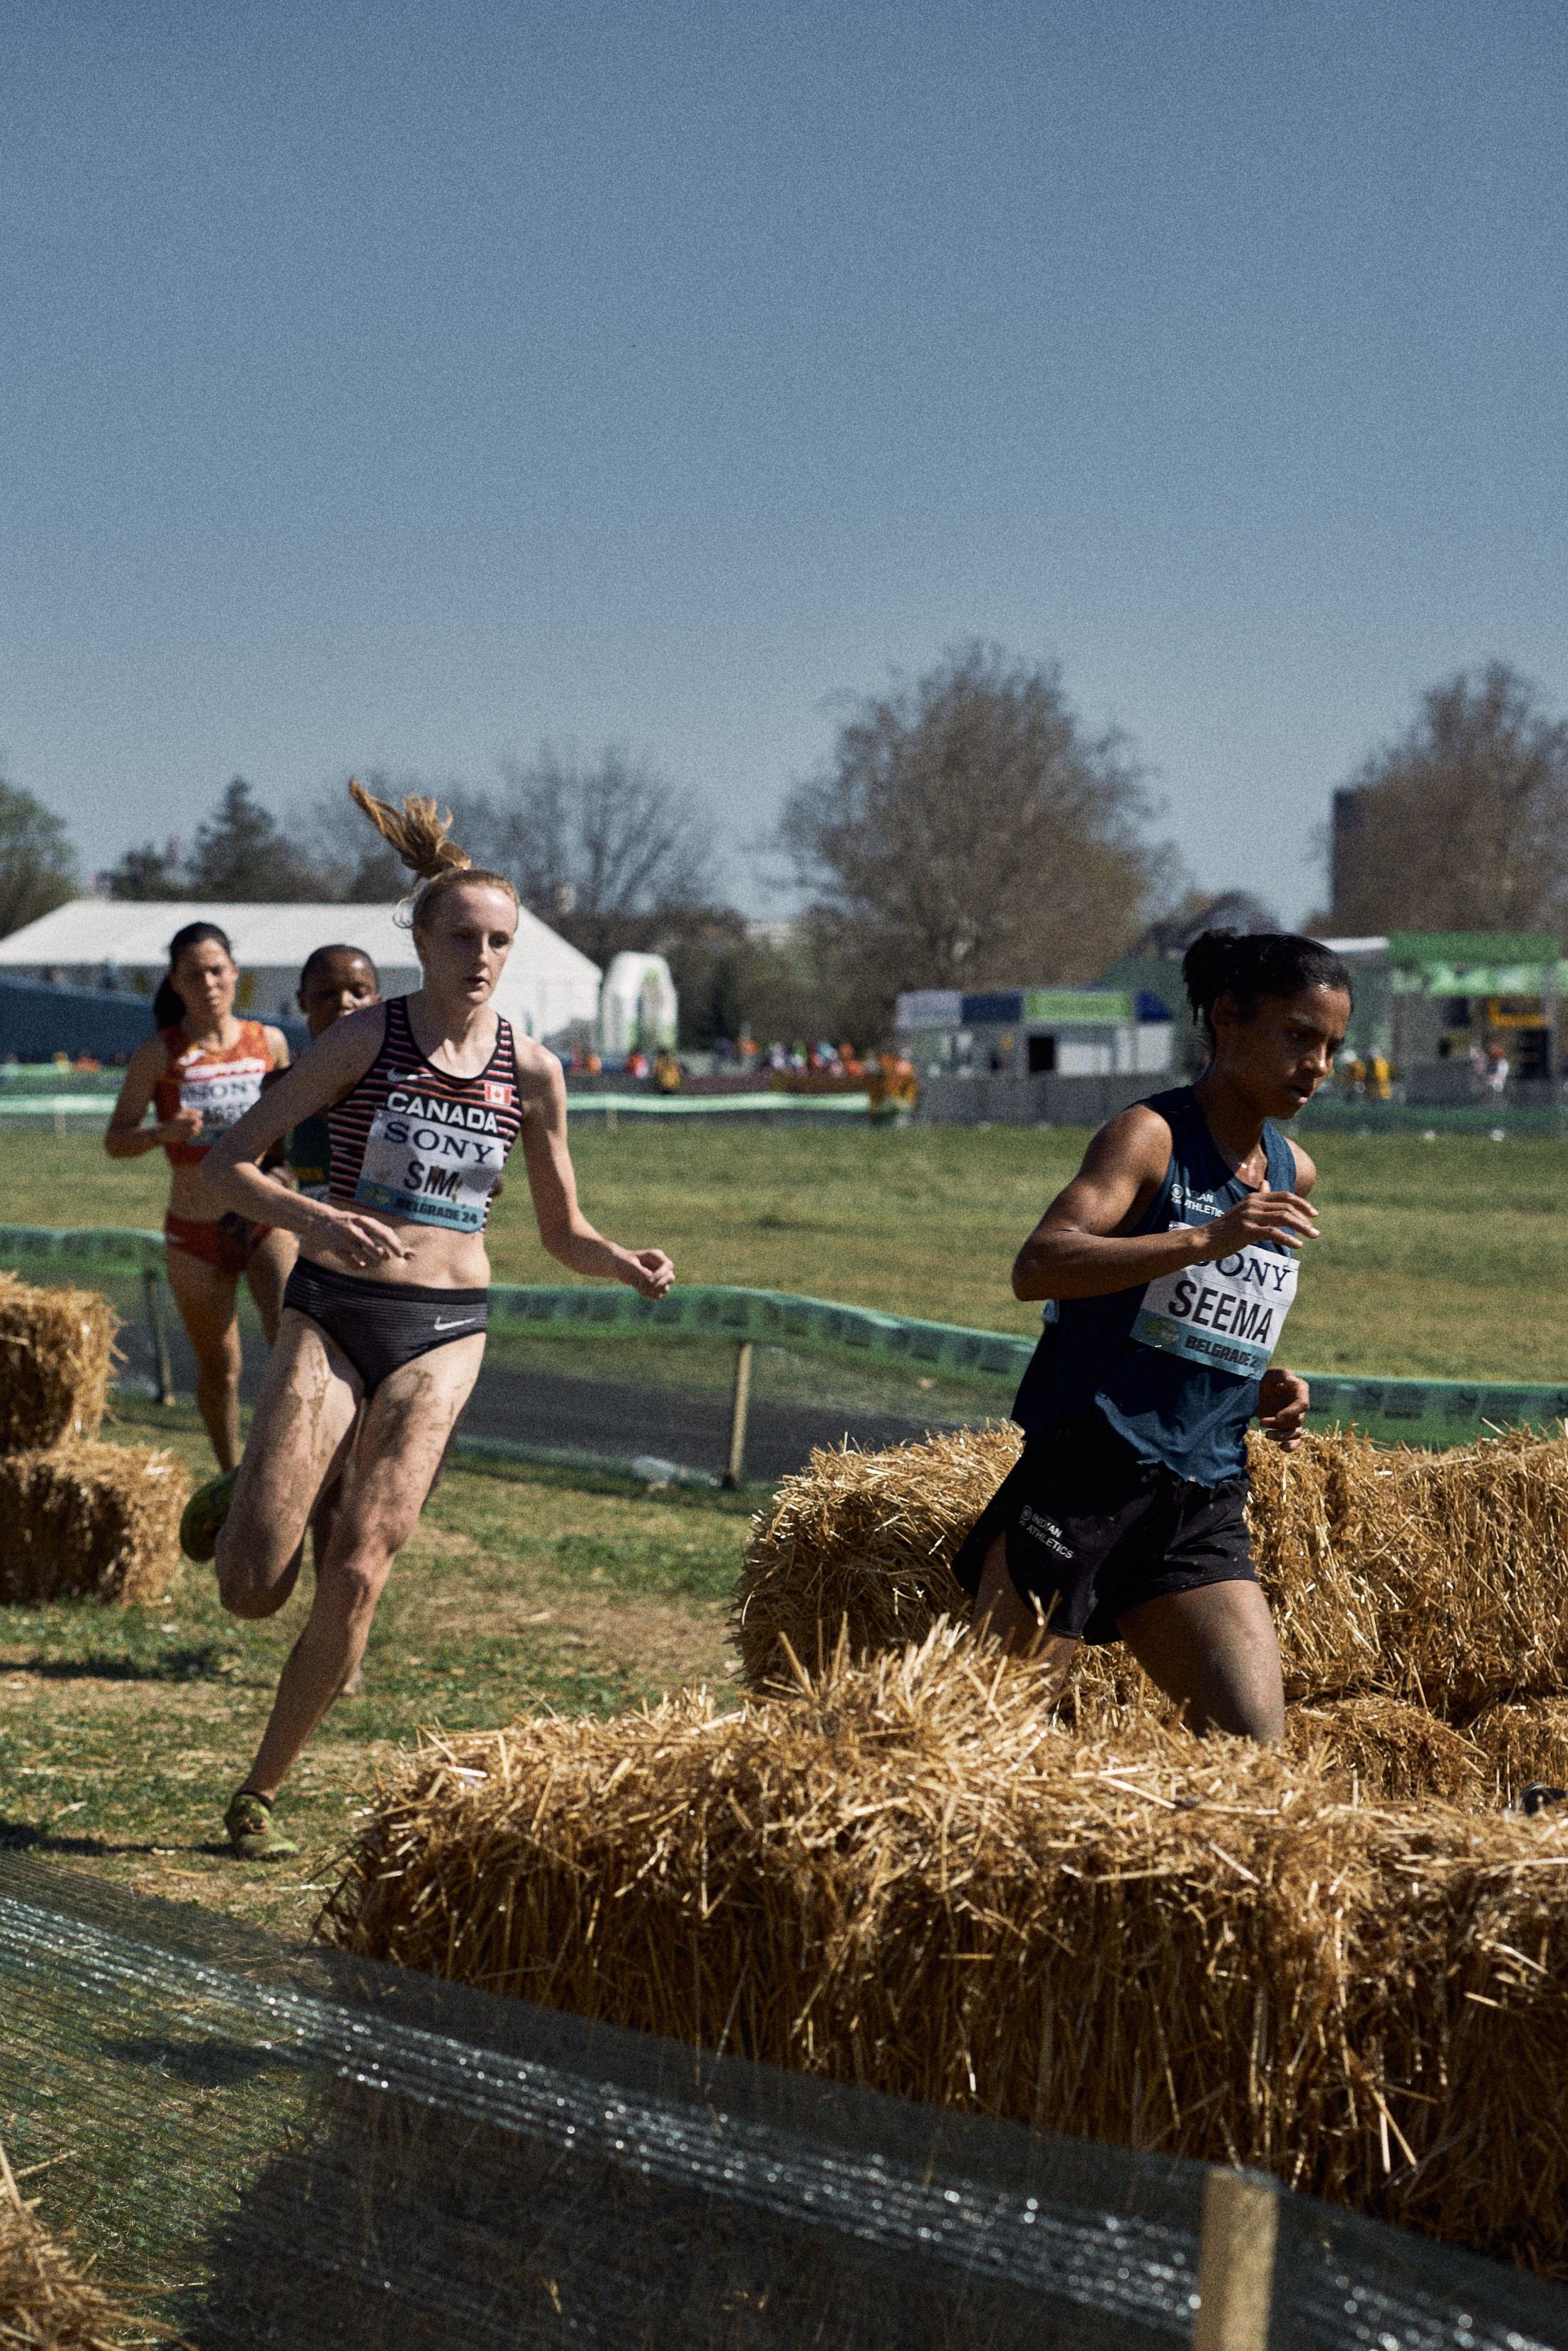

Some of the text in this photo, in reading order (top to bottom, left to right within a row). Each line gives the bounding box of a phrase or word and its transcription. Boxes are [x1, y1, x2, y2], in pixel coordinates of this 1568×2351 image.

[387, 1091, 499, 1133] CANADA
[385, 1121, 494, 1163] SONY
[404, 1161, 460, 1197] SIM
[396, 1197, 478, 1224] BELGRADE 24
[1168, 1280, 1274, 1344] SEEMA
[1026, 1525, 1074, 1559] ATHLETICS
[1032, 1513, 1063, 1538] INDIAN
